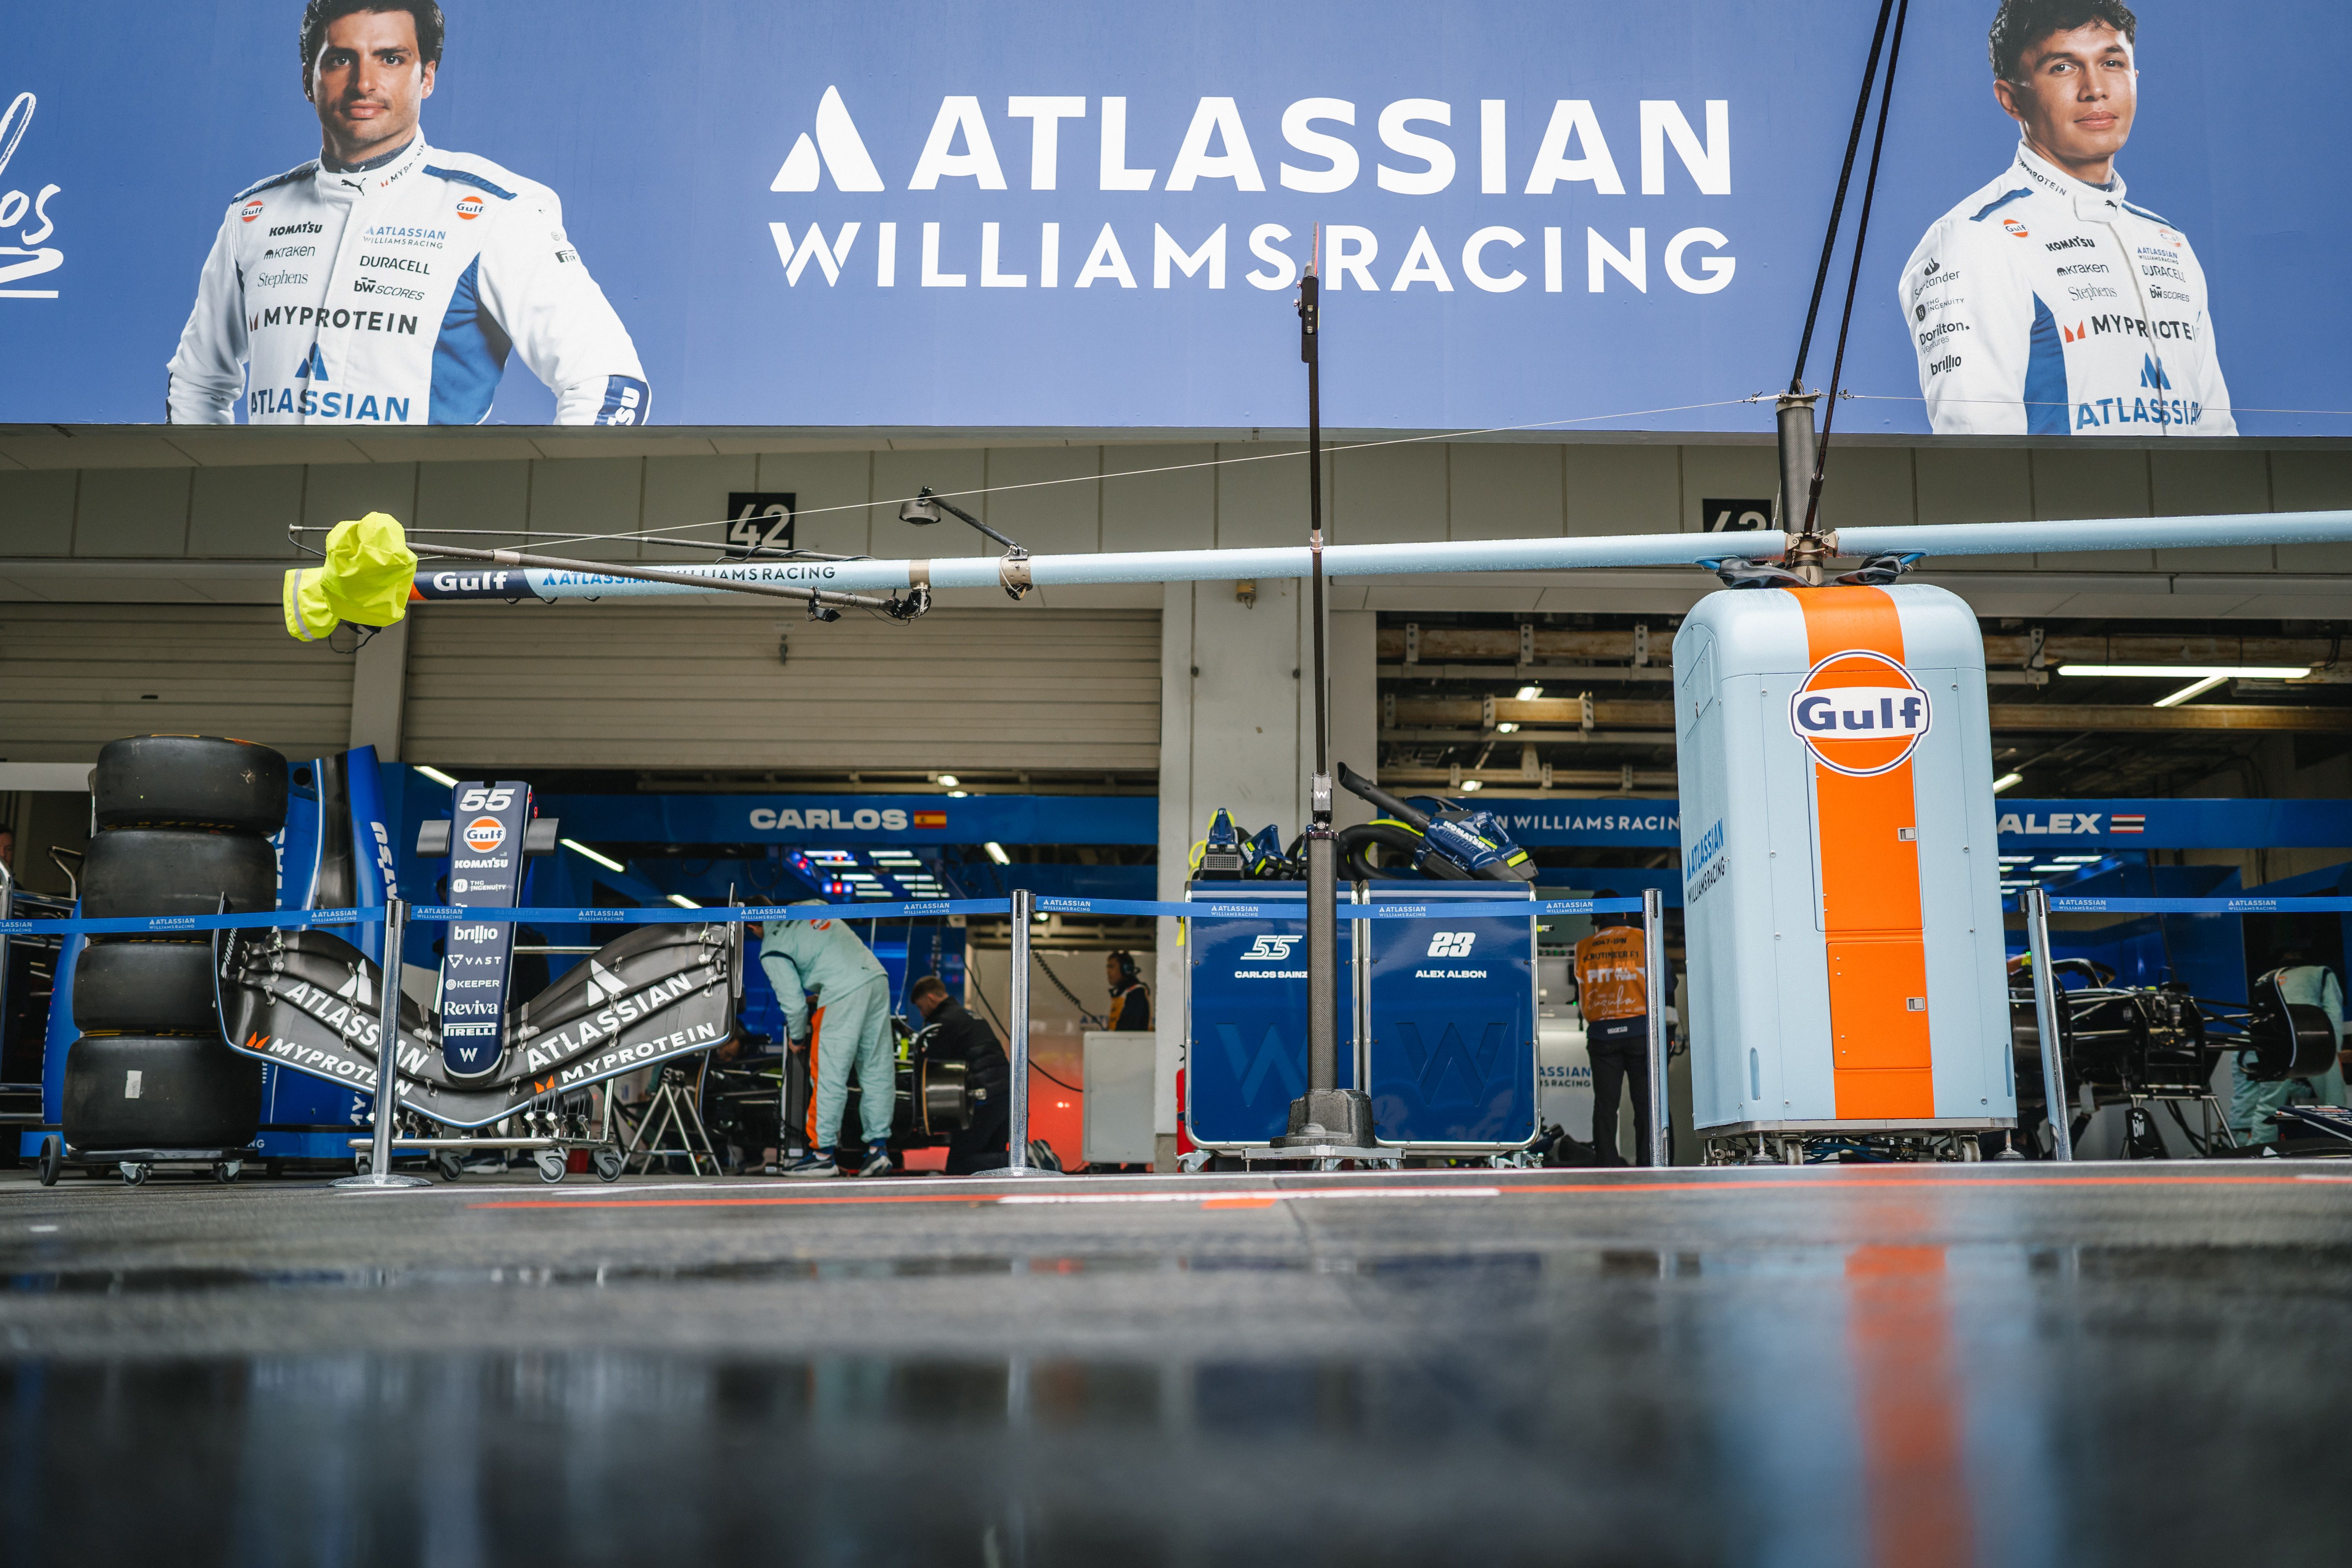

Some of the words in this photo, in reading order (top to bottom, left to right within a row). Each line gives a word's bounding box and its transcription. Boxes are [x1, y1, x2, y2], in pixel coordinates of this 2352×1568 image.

[908, 96, 1731, 195] ATLASSIAN
[242, 207, 263, 216] Gulf
[456, 203, 485, 213] Gulf
[269, 221, 323, 237] KOMATSU
[377, 227, 446, 240] ATLASSIAN
[2005, 223, 2028, 234] Gulf
[2045, 236, 2096, 252] KOMATSU
[2143, 247, 2178, 260] ATLASSIAN
[359, 255, 430, 275] DURACELL
[2141, 265, 2186, 283] DURACELL
[257, 269, 309, 289] Stephens
[2067, 283, 2118, 302] Stephens
[264, 305, 418, 335] MYPROTEIN
[1921, 335, 1950, 354] Ventures
[251, 387, 410, 422] ATLASSIAN
[730, 504, 791, 548] 42
[433, 571, 509, 592] Gulf
[1797, 696, 1922, 731] Gulf
[459, 788, 515, 812] 55
[749, 808, 908, 831] CARLOS
[1997, 813, 2103, 835] ALEX
[466, 829, 503, 839] Gulf
[1443, 820, 1486, 849] KOMATSU
[1691, 817, 1724, 877] ATLASSIAN
[454, 857, 508, 869] KOMATSU
[318, 909, 357, 918] ATLASSIAN
[1240, 935, 1303, 961] 55
[1427, 932, 1476, 958] 23
[457, 979, 500, 988] KEEPER
[1234, 971, 1276, 979] CARLOS
[1278, 971, 1308, 979] SAINZ
[1415, 970, 1445, 978] ALEX
[1446, 970, 1487, 979] ALBON
[444, 1000, 498, 1016] Reviva
[443, 1022, 497, 1037] PIRELLI
[526, 972, 693, 1073] ATLASSIAN
[561, 1022, 716, 1083] MYPROTEIN
